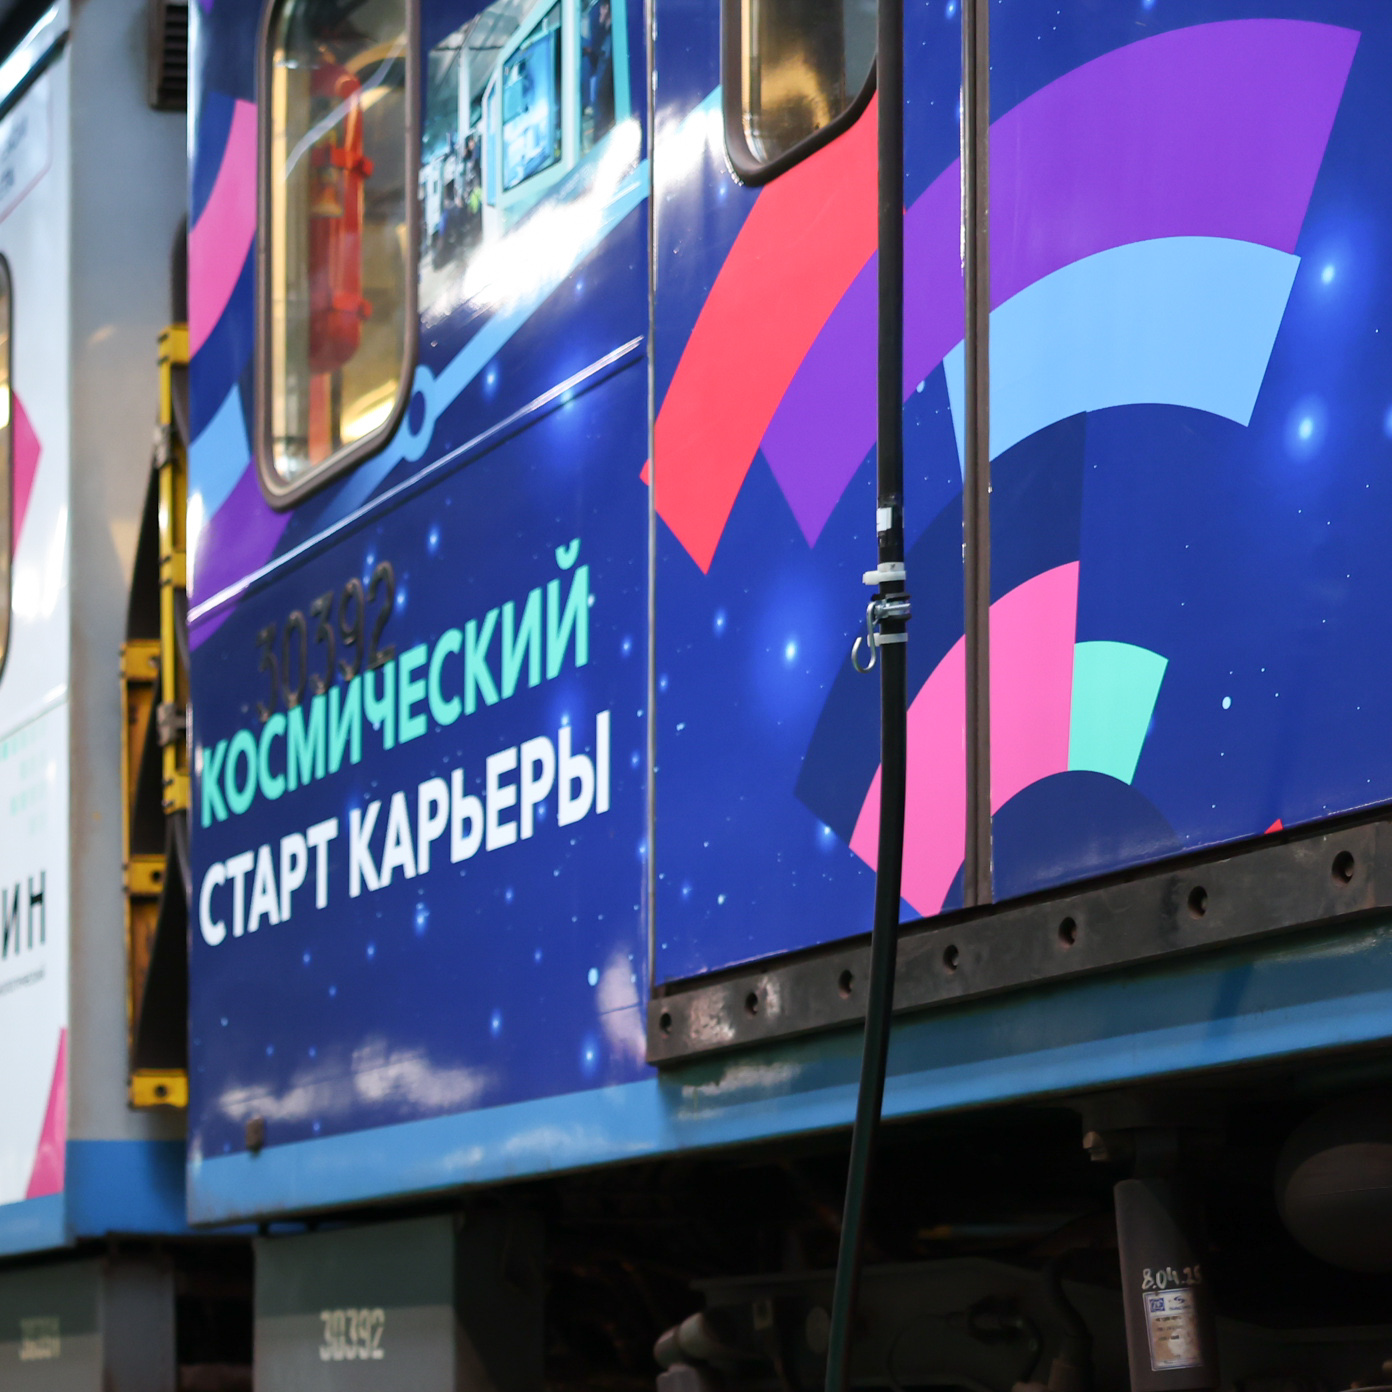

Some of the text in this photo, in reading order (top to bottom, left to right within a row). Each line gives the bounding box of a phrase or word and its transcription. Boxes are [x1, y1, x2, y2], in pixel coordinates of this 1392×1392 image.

[200, 538, 590, 828] КОСМИЧЕСКИЙ
[255, 560, 397, 721] 30392
[198, 710, 611, 946] СТАРТ КАРЬЕРЫ
[319, 1308, 385, 1362] 30392
